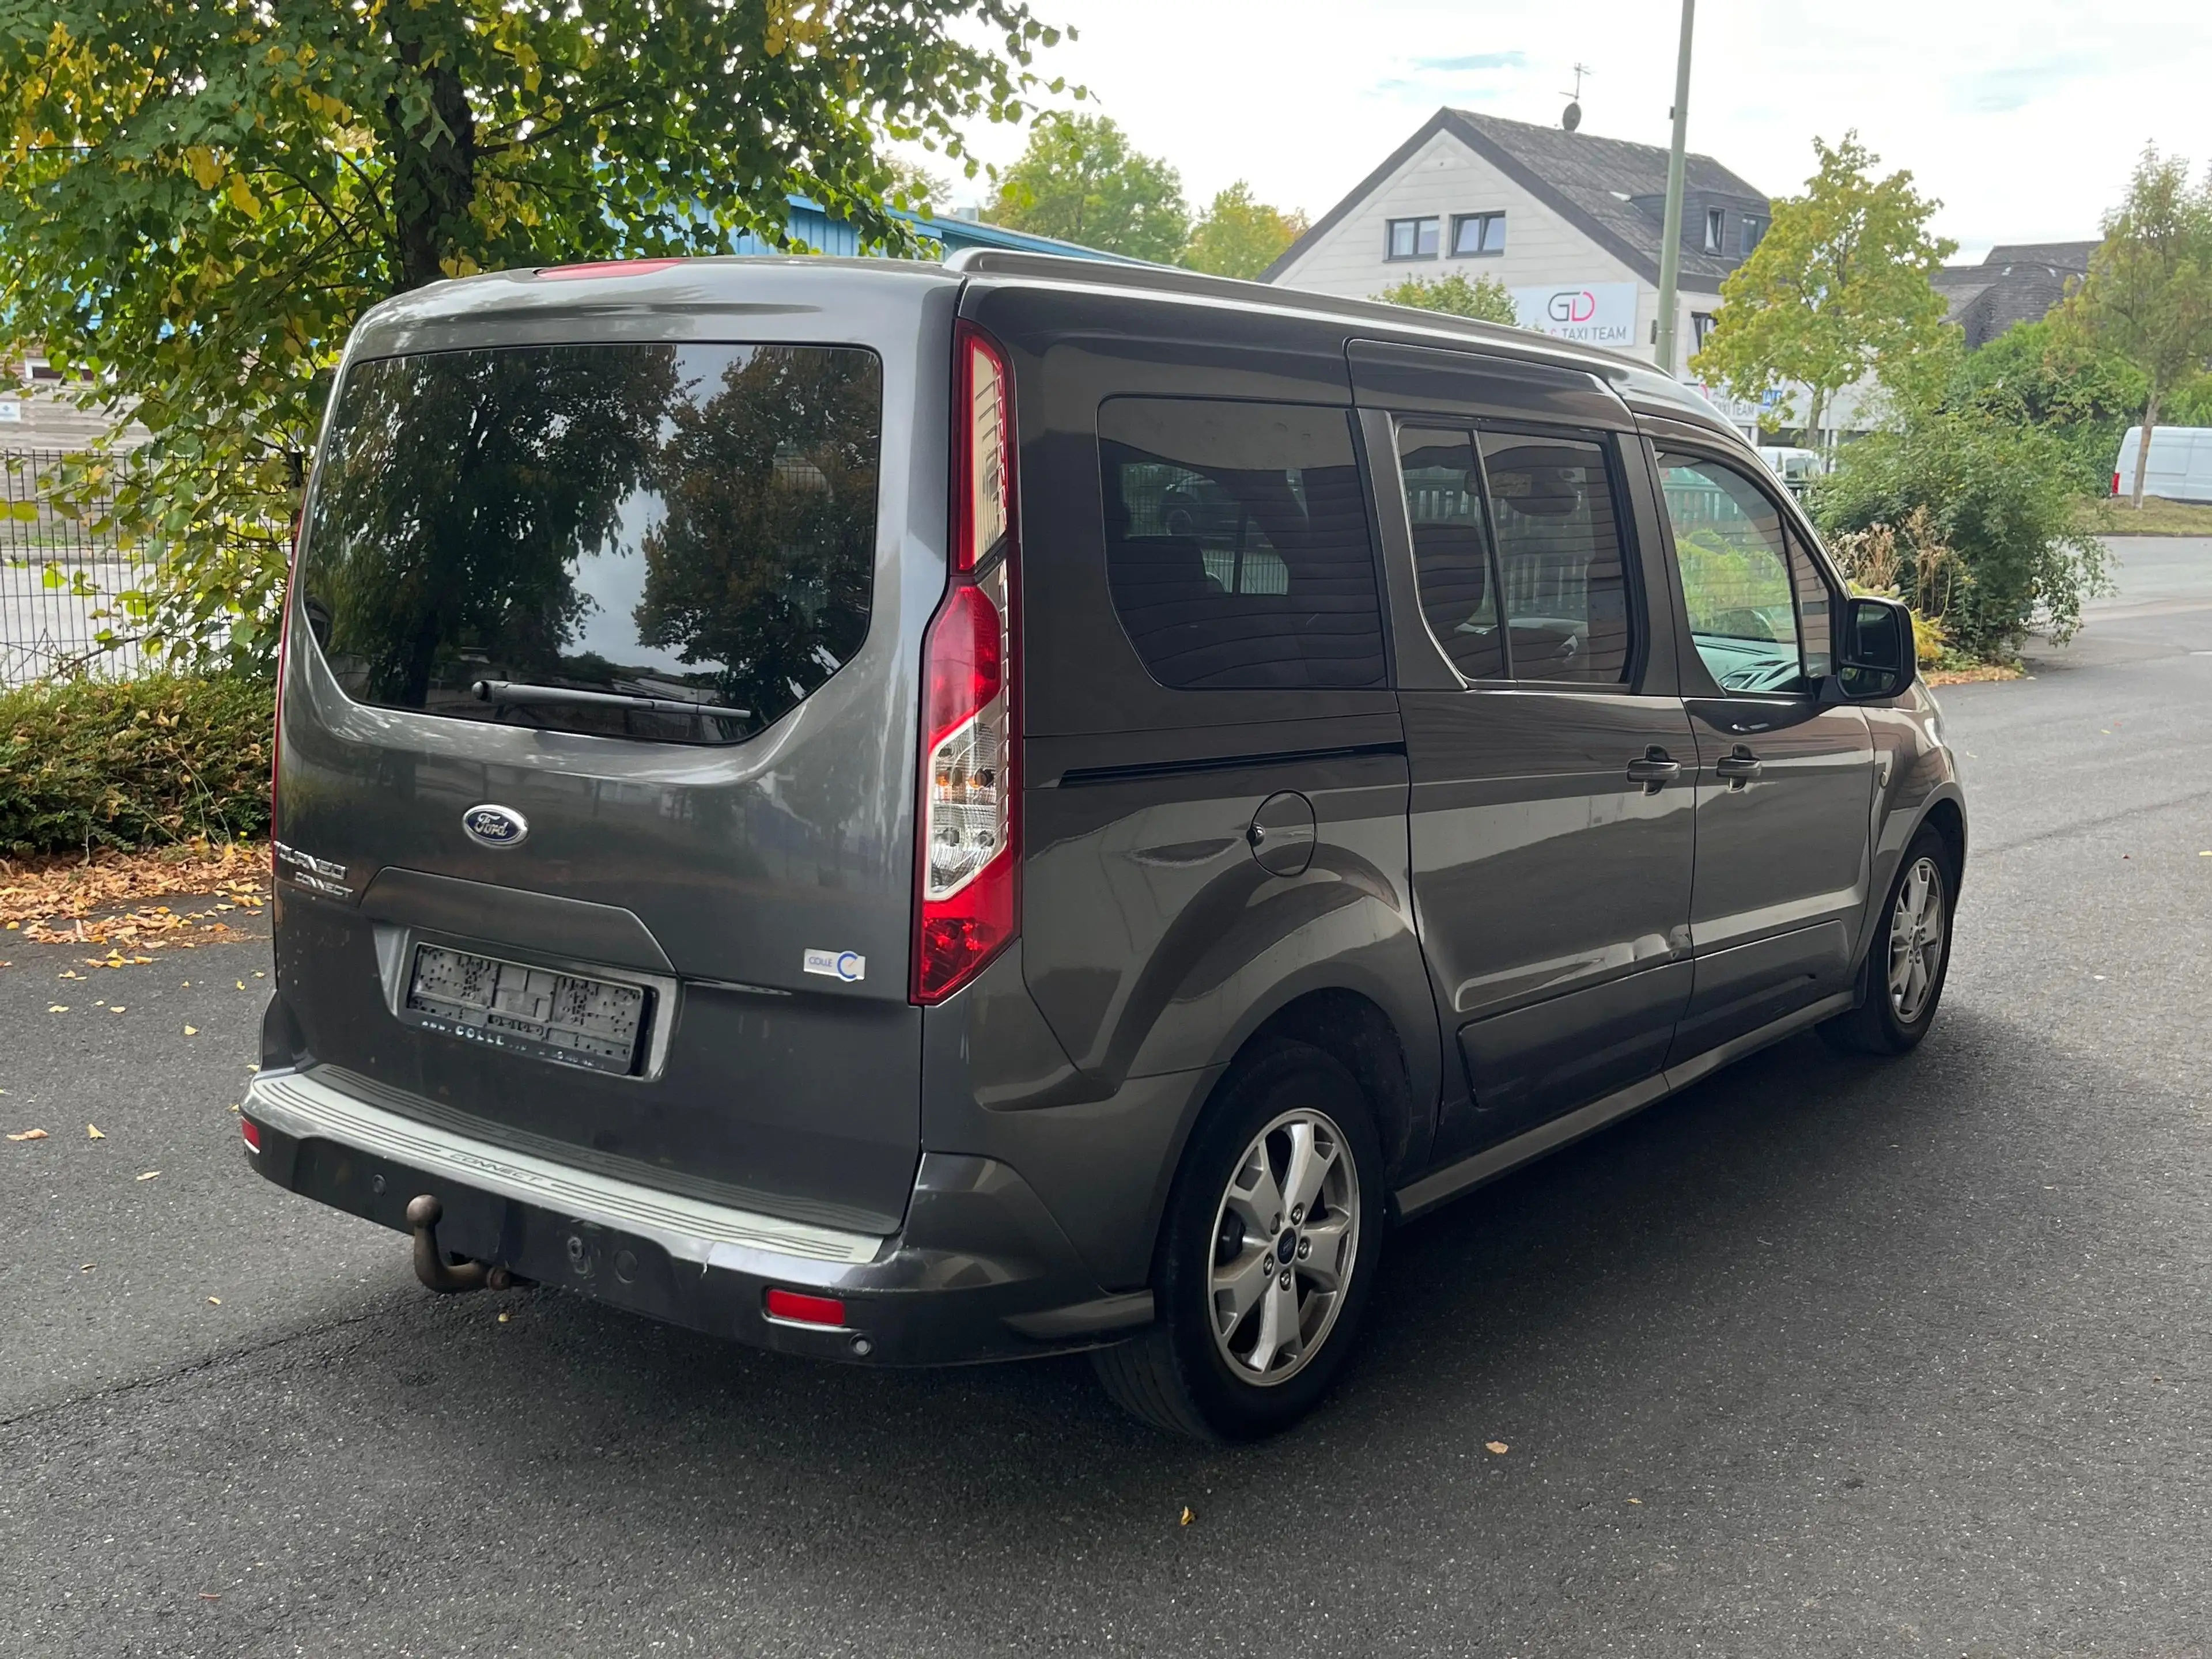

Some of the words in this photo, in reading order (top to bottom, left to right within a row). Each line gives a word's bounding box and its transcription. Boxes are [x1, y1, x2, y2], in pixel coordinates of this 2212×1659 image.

[1562, 328, 1588, 340] TAXI
[1592, 327, 1626, 340] TEAM
[474, 813, 509, 836] Ford
[295, 872, 353, 897] CONNECT
[808, 956, 833, 967] COLLE
[450, 1153, 543, 1181] CONNECT
